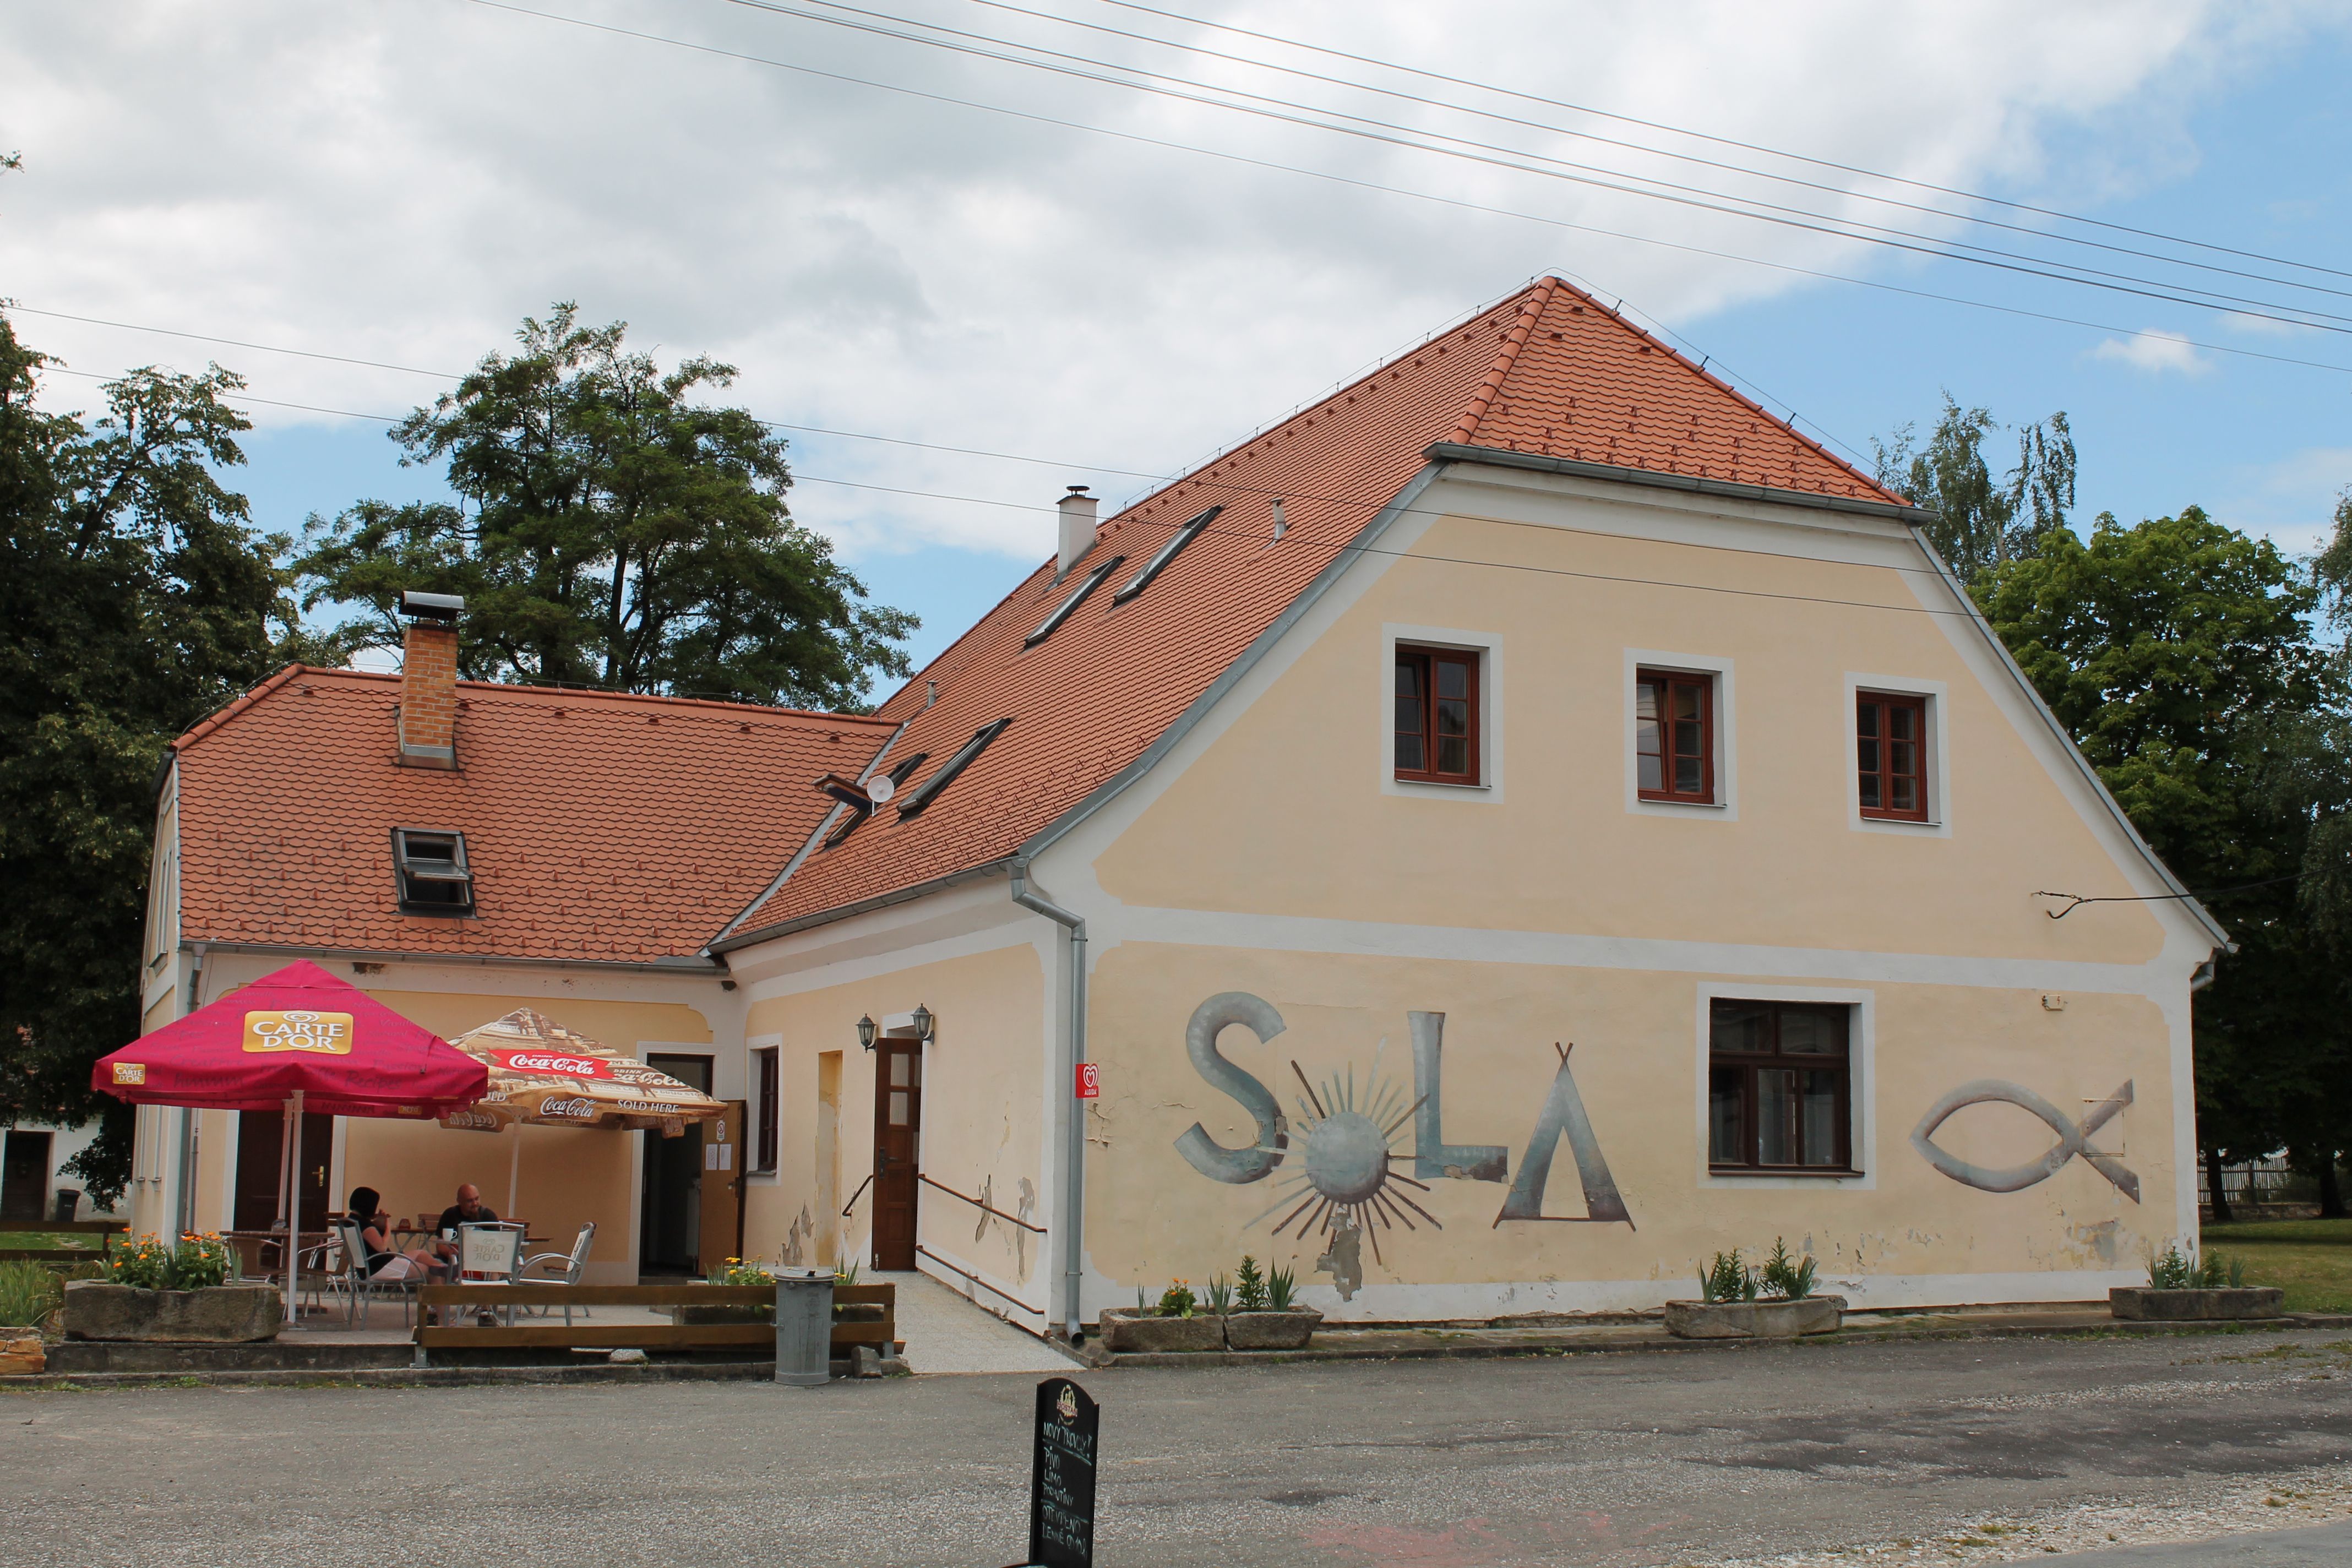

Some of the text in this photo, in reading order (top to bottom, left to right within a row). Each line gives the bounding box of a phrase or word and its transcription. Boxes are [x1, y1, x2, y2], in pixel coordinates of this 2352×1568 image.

[253, 1021, 344, 1038] CARTE
[263, 1033, 337, 1051] D'OR
[116, 1068, 143, 1076] CARTE
[509, 1054, 595, 1075] Coca-Cola
[540, 1096, 596, 1118] Coca-Cola
[617, 1100, 679, 1113] SOLD HERE
